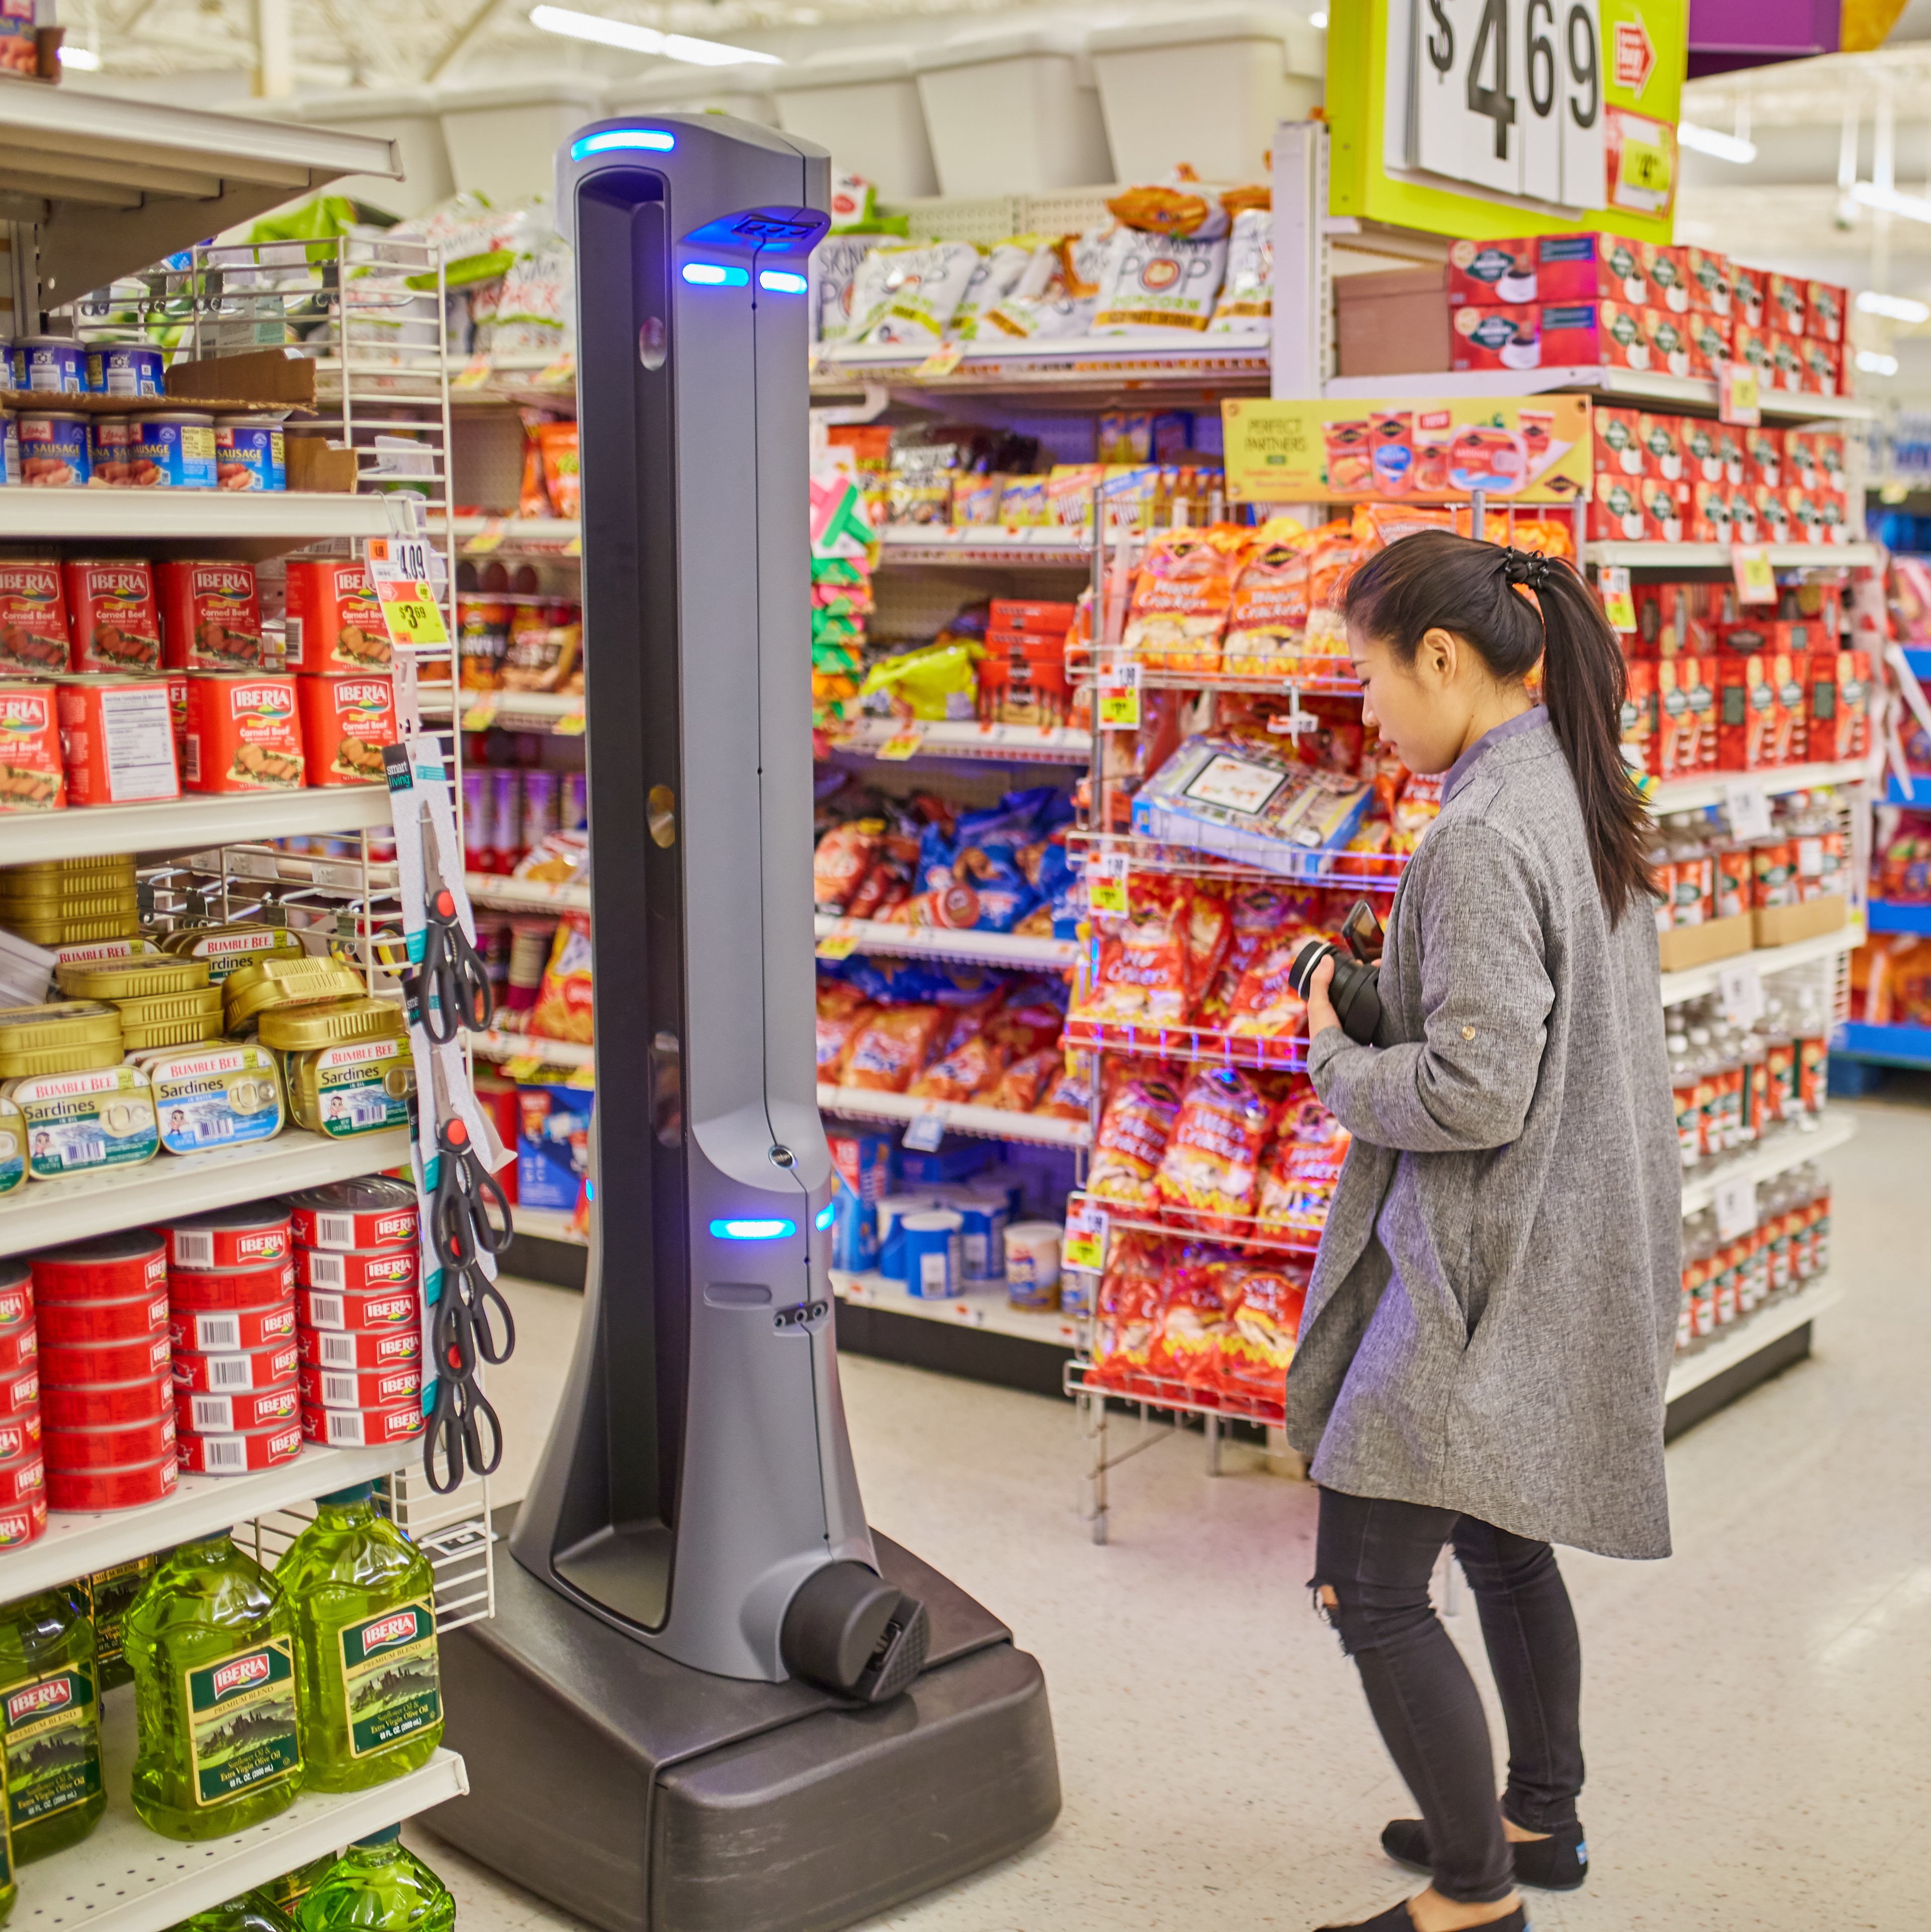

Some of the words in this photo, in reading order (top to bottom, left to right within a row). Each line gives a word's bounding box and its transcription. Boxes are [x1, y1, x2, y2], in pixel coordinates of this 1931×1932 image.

[1114, 255, 1211, 296] POP
[1248, 418, 1301, 435] PERFECT
[33, 443, 80, 454] SAUSAGE
[1244, 436, 1306, 451] PARTNERS
[217, 449, 262, 459] SAUSAGE
[92, 574, 145, 593] IBERIA
[197, 573, 250, 592] IBERIA
[3, 611, 34, 620] Corned
[36, 610, 55, 619] Beef
[96, 610, 125, 619] Corned
[127, 609, 145, 619] Beef
[201, 608, 229, 616] Corned
[232, 607, 249, 616] Beef
[342, 609, 368, 618] Corned
[236, 691, 290, 709] IBERIA
[340, 685, 387, 703] IBERIA
[240, 726, 269, 737] Corned
[272, 726, 290, 736] Beef
[343, 721, 370, 732] Corned
[372, 719, 387, 730] Beef
[19, 740, 43, 752] Beef
[387, 761, 407, 775] smart
[389, 774, 410, 788] living
[208, 939, 248, 954] BUMBLE
[251, 936, 270, 948] BEE
[331, 1048, 372, 1065] BUMBLE
[375, 1044, 393, 1058] BEE
[171, 1061, 216, 1078] BUMBLE
[218, 1057, 238, 1070] BEE
[322, 1067, 379, 1086] Sardines
[35, 1081, 89, 1099] BUMBLE
[91, 1077, 114, 1091] BEE
[160, 1079, 224, 1099] Sardines
[24, 1100, 96, 1120] Sardines
[379, 1217, 415, 1235] IBERIA
[241, 1235, 283, 1253] IBERIA
[368, 1259, 411, 1277] IBERIA
[367, 1299, 411, 1318] IBERIA
[381, 1336, 418, 1355] IBERIA
[382, 1374, 421, 1394] IBERIA
[258, 1393, 295, 1415] IBERIA
[271, 1429, 301, 1453] IBERIA
[366, 1616, 414, 1644] IBERIA
[363, 1652, 396, 1669] PREMIUM
[397, 1643, 422, 1660] BLEND
[218, 1658, 267, 1687] IBERIA
[12, 1682, 67, 1714] IBERIA
[214, 1697, 248, 1715] PREMIUM
[248, 1685, 274, 1700] BLEND
[370, 1723, 385, 1735] Extra
[385, 1715, 403, 1728] Virgin
[403, 1710, 418, 1721] Olive
[418, 1704, 429, 1715] Oil
[377, 1708, 403, 1723] Sunflower
[403, 1702, 412, 1712] Oil
[9, 1721, 46, 1740] PREMIUM
[49, 1710, 77, 1723] BLEND
[220, 1770, 236, 1782] Extra
[235, 1761, 254, 1775] Virgin
[255, 1756, 271, 1767] Olive
[270, 1749, 281, 1760] Oil
[228, 1754, 254, 1770] Sunflower
[255, 1748, 264, 1758] Oil
[265, 1746, 271, 1754] &
[17, 1798, 35, 1810] Extra
[56, 1782, 73, 1793] Olive
[73, 1775, 86, 1787] Oil
